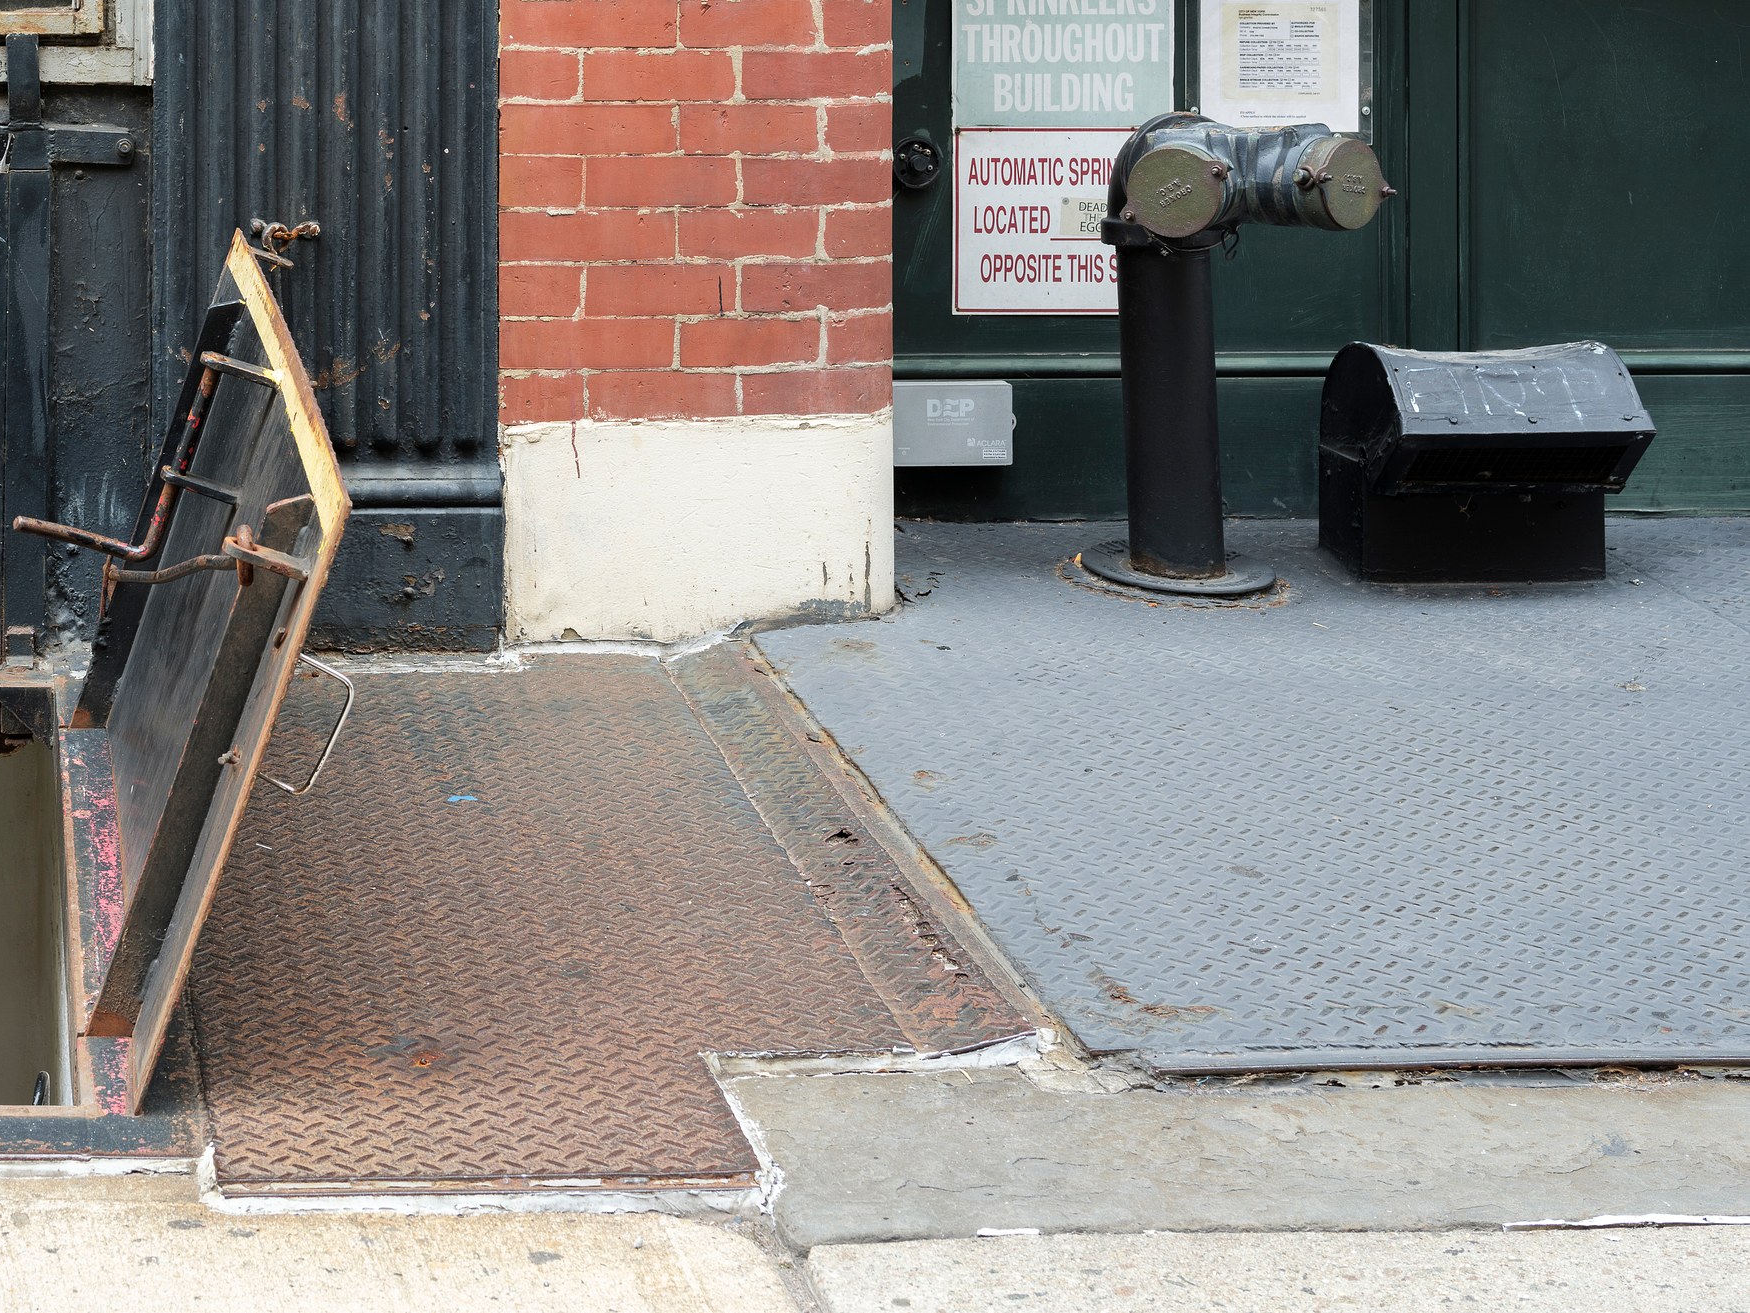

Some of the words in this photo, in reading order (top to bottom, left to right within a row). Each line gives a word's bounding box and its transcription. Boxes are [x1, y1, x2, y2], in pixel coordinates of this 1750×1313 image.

[962, 23, 1164, 63] THROUGHOUT
[994, 72, 1134, 112] BUILDING
[968, 157, 1064, 186] AUTOMATIC
[974, 205, 1051, 234] LOCATED
[980, 254, 1062, 283] OPPOSITE
[1067, 254, 1104, 283] THIS
